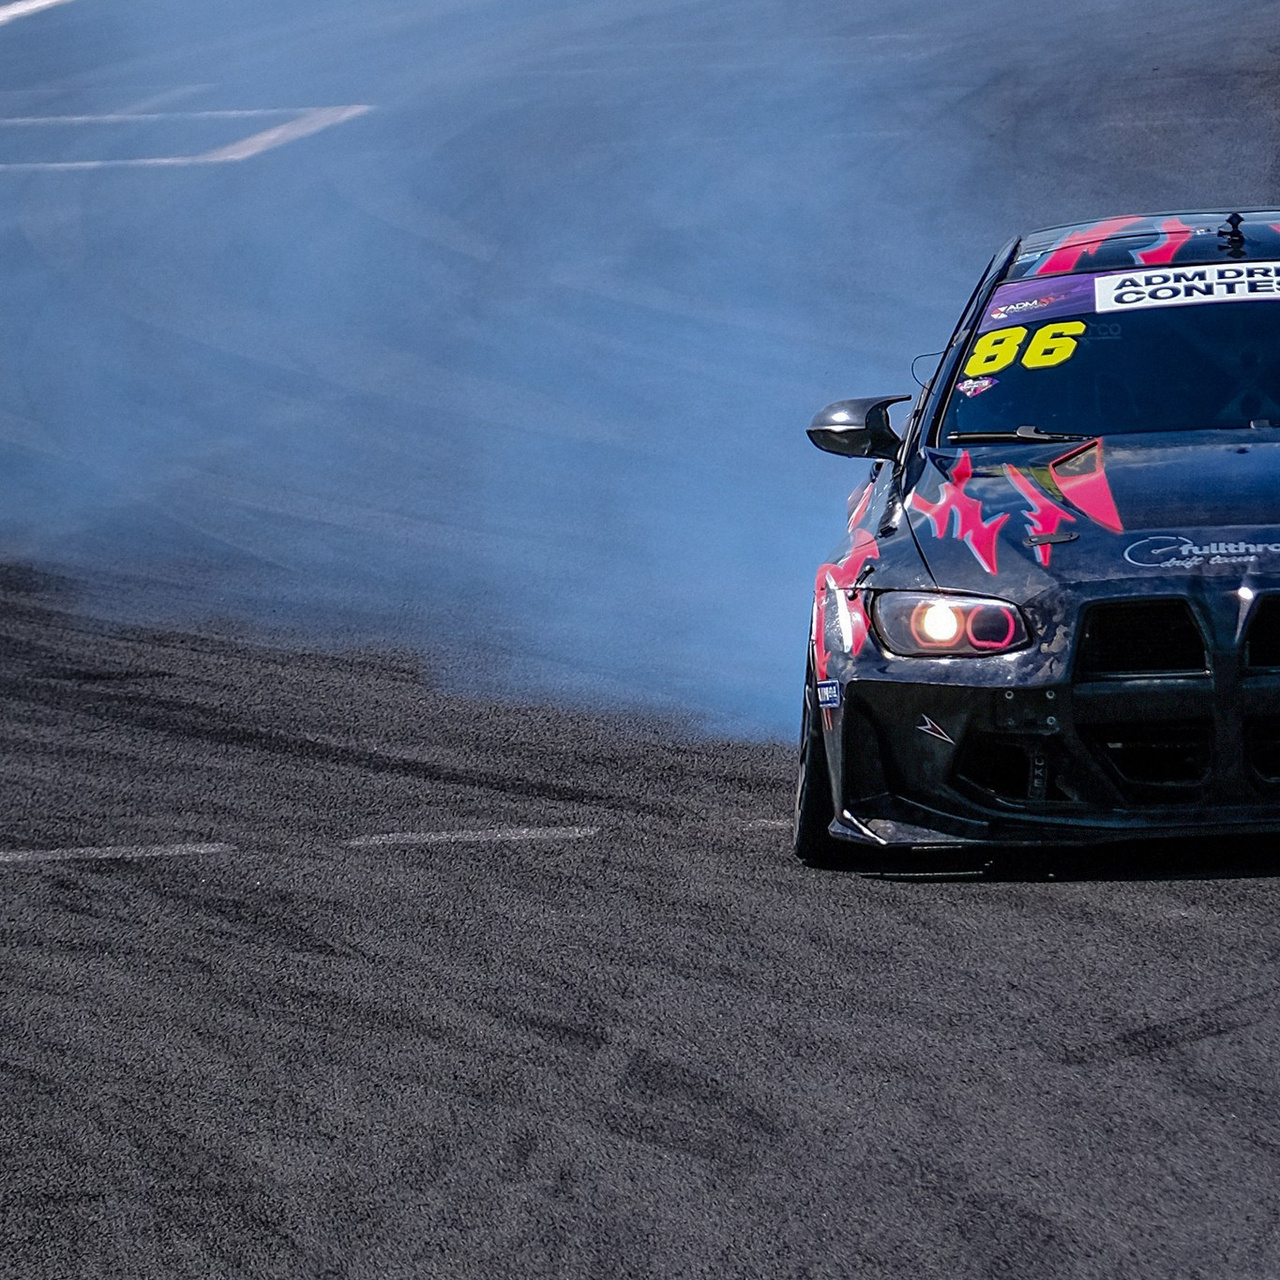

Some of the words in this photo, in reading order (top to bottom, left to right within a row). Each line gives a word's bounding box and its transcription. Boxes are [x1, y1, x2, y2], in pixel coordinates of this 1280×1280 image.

[1113, 270, 1207, 291] ADM
[1007, 299, 1040, 312] ADM
[963, 321, 1087, 378] 86
